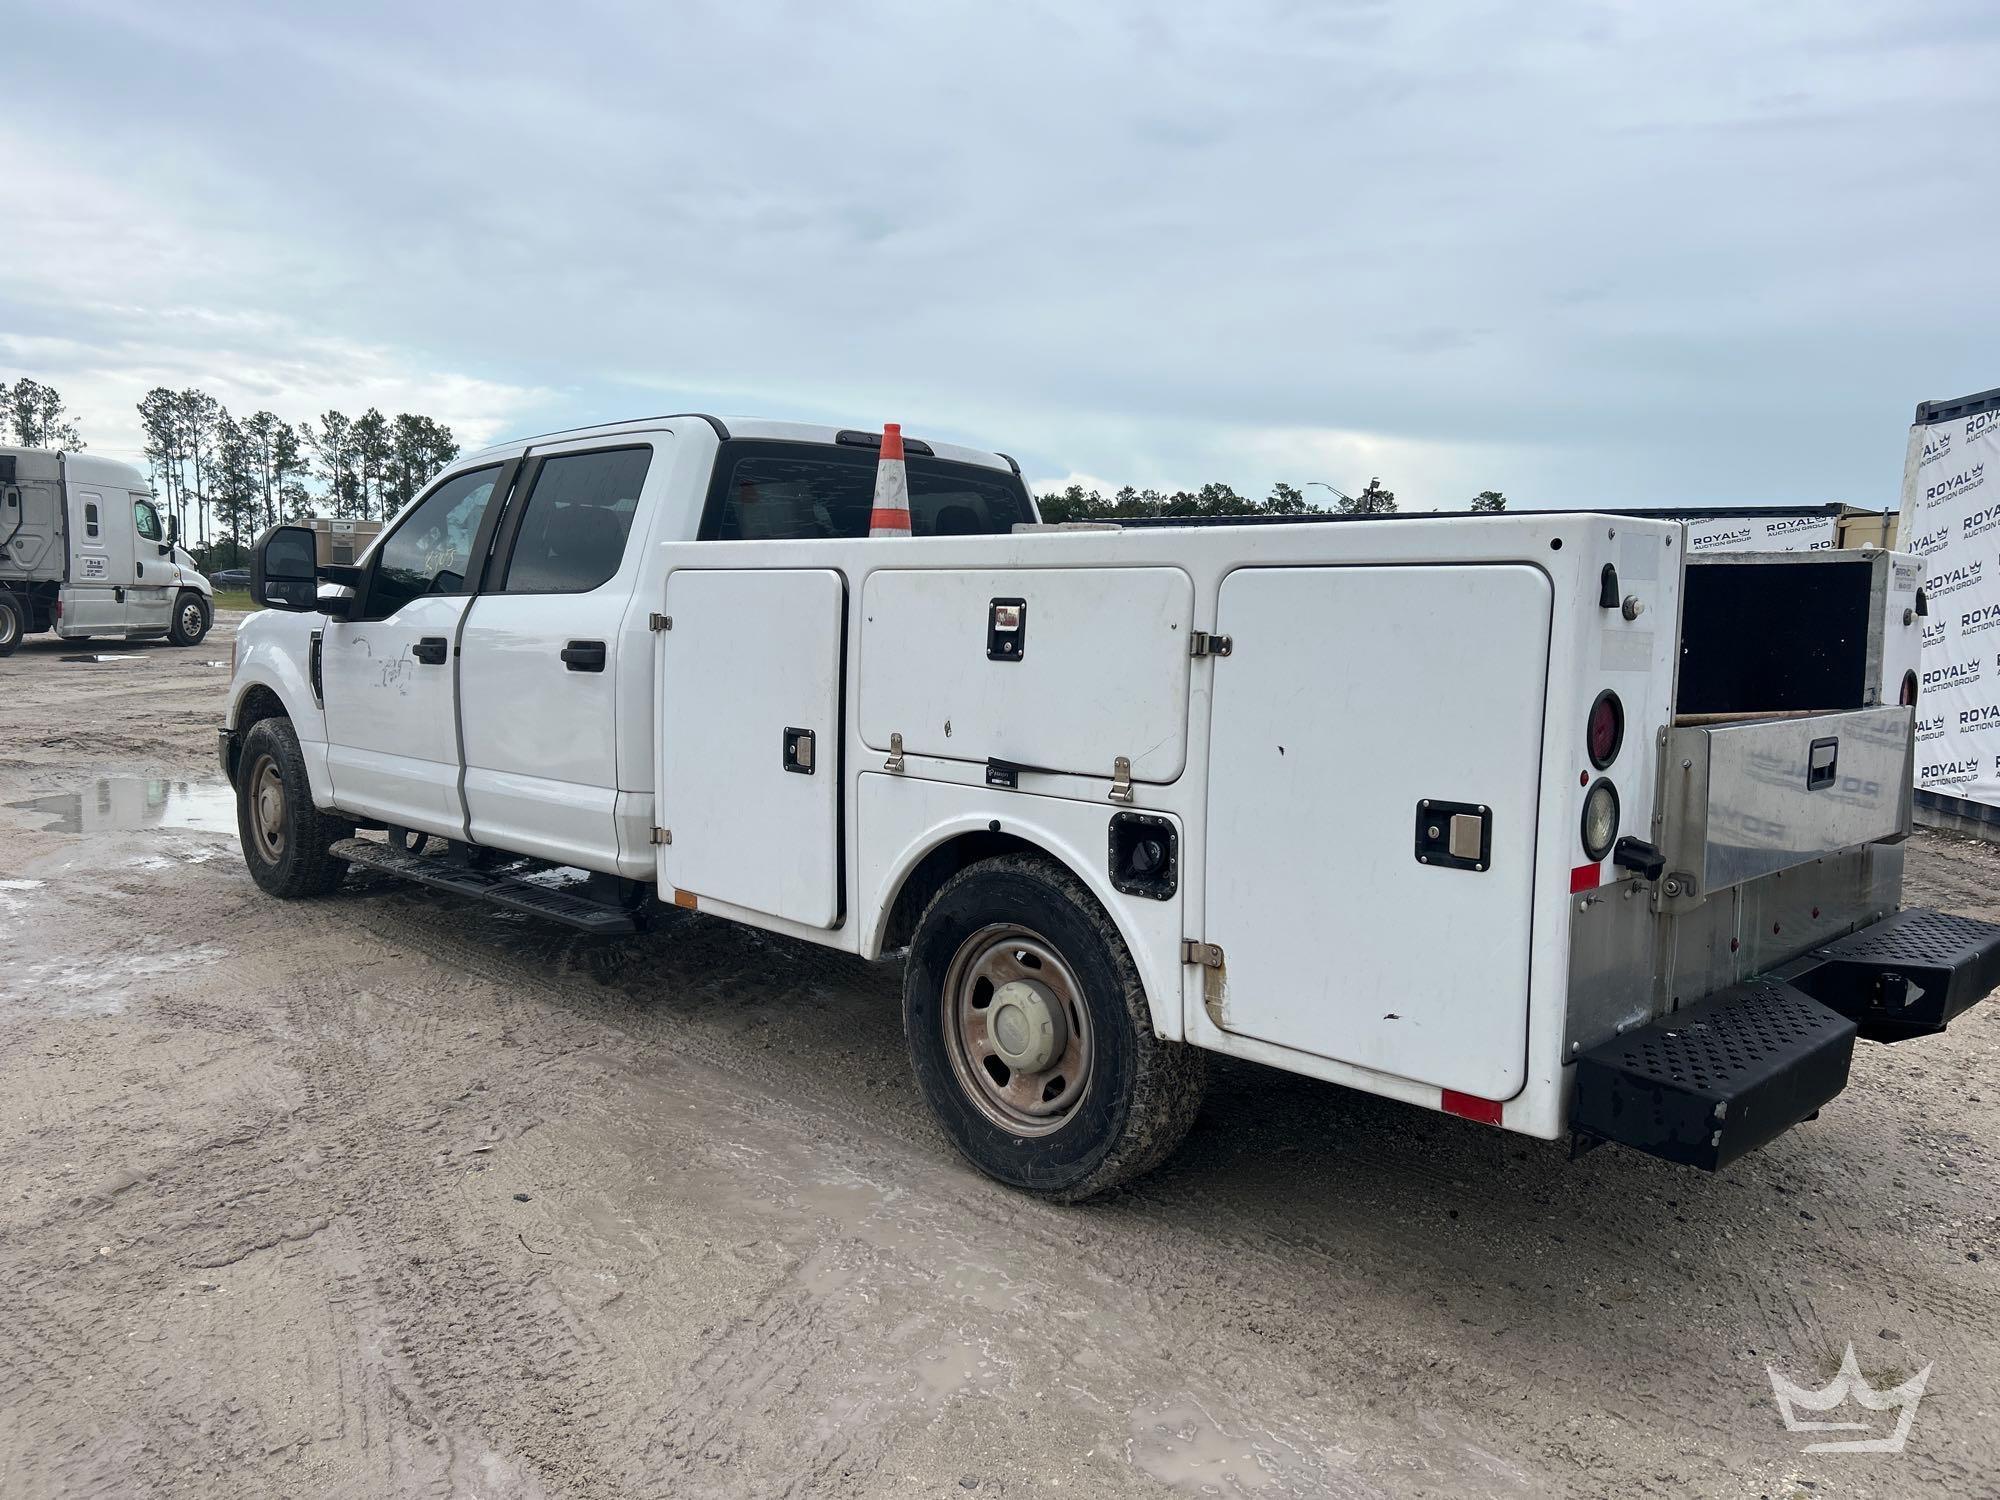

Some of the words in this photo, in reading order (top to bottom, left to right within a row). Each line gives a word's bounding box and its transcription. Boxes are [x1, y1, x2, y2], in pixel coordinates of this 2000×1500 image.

[1966, 422, 1998, 445] AUCTION
[1926, 447, 1951, 465] GROUP
[1927, 471, 1971, 500] ROYAL
[1927, 490, 1958, 509] AUCTION
[1958, 478, 1984, 495] GROUP
[1766, 518, 1814, 532] ROYAL
[1768, 528, 1800, 537] AUCTION
[1801, 522, 1829, 531] GROUP
[1964, 521, 1996, 540] AUCTION
[1693, 532, 1738, 546] ROYAL
[1694, 541, 1726, 550] AUCTION
[1726, 536, 1752, 545] GROUP
[1924, 541, 1949, 556] GROUP
[1926, 567, 1969, 592] ROYAL
[1956, 575, 1982, 591] GROUP
[1962, 620, 1995, 637] AUCTION
[1922, 635, 1946, 648] GROUP
[1923, 664, 1967, 685] ROYAL
[1923, 681, 1953, 694] AUCTION
[1954, 674, 1980, 687] GROUP
[1960, 721, 1993, 734] AUCTION
[1920, 731, 1945, 741] GROUP
[1921, 761, 1965, 778] ROYAL
[1921, 777, 1951, 788] AUCTION
[1952, 774, 1979, 784] GROUP
